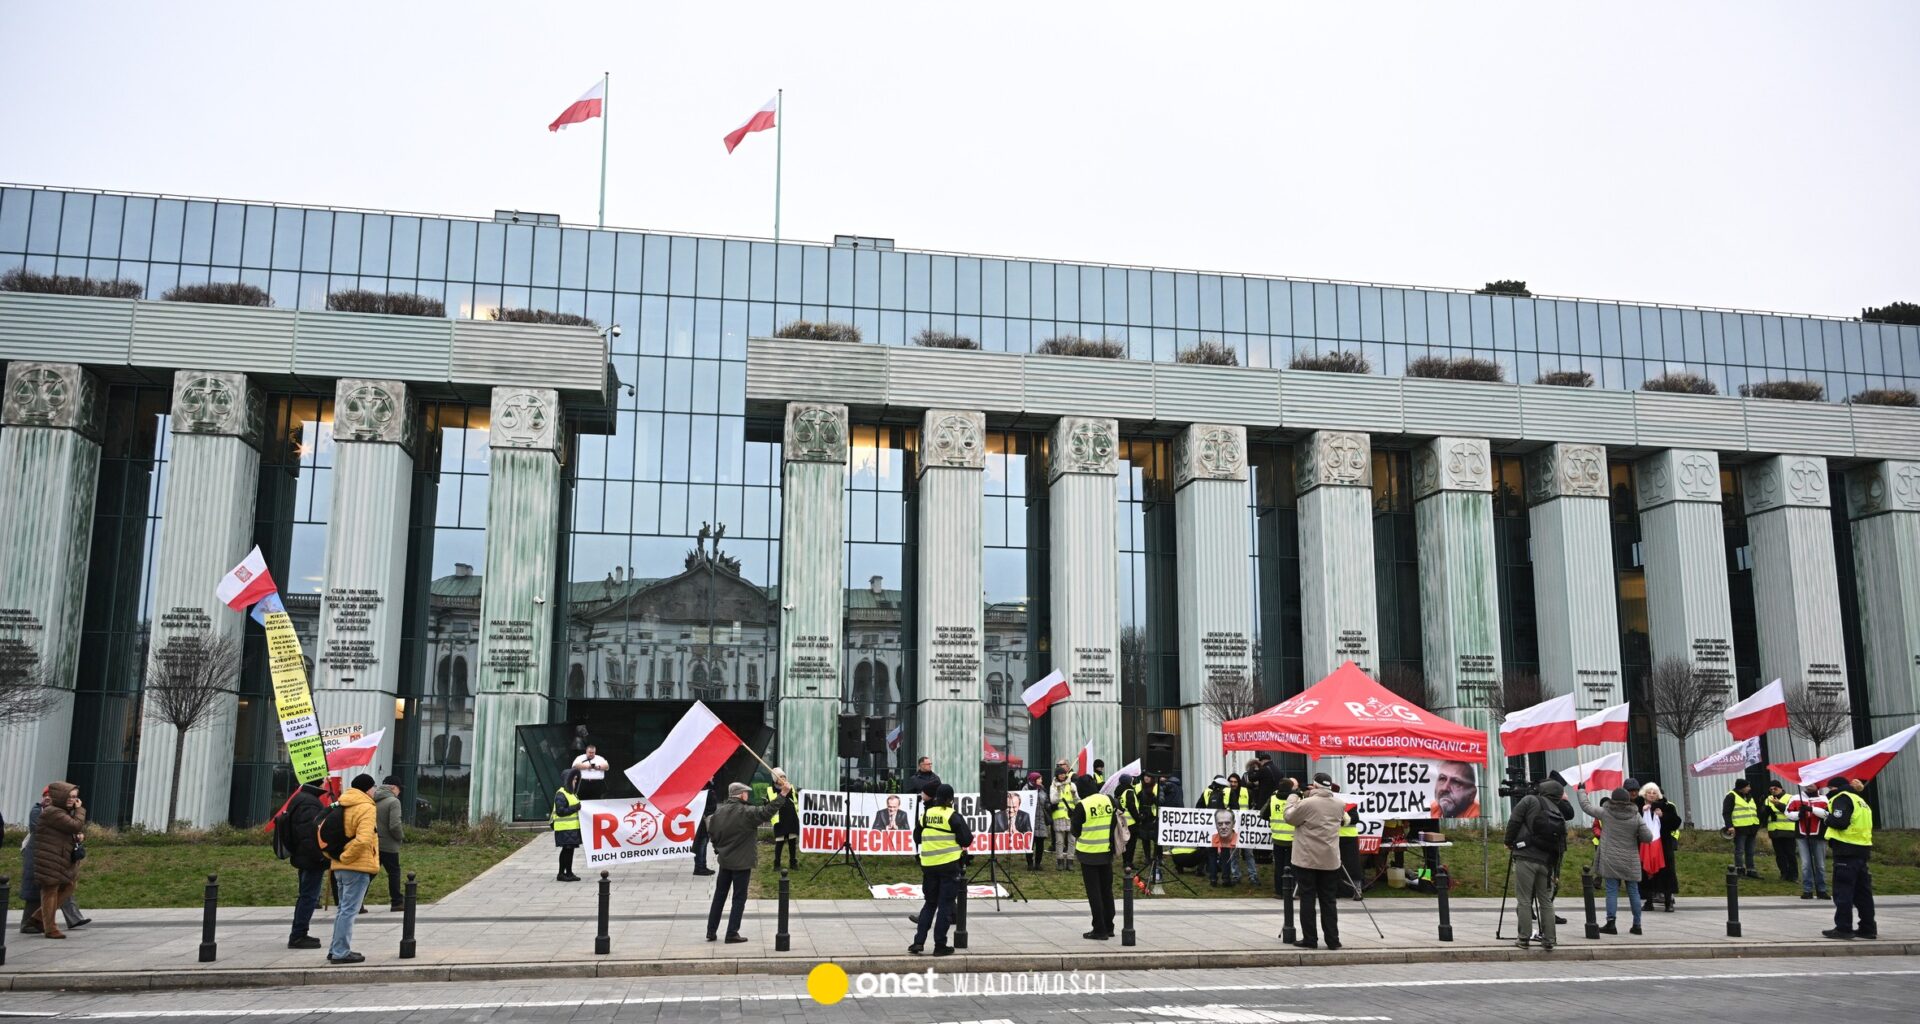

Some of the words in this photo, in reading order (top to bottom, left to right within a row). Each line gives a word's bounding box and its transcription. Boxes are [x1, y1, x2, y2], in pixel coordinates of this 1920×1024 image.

[320, 726, 351, 738] EZYDENT
[1238, 730, 1311, 744] RUCHOBRONYGRANIC.PL
[1348, 736, 1482, 754] RUCHOBRONYGRANIC.PL
[1346, 762, 1431, 790] BĘDZIESZ
[804, 793, 843, 812] MAM
[1162, 810, 1213, 826] BĘDZIESZ
[1358, 821, 1381, 834] OP
[1162, 829, 1211, 844] SIEDZIAŁ
[1240, 831, 1272, 844] SIEDZI
[592, 852, 617, 862] RUCH
[620, 848, 660, 859] OBRONY
[662, 846, 692, 855] GRANI
